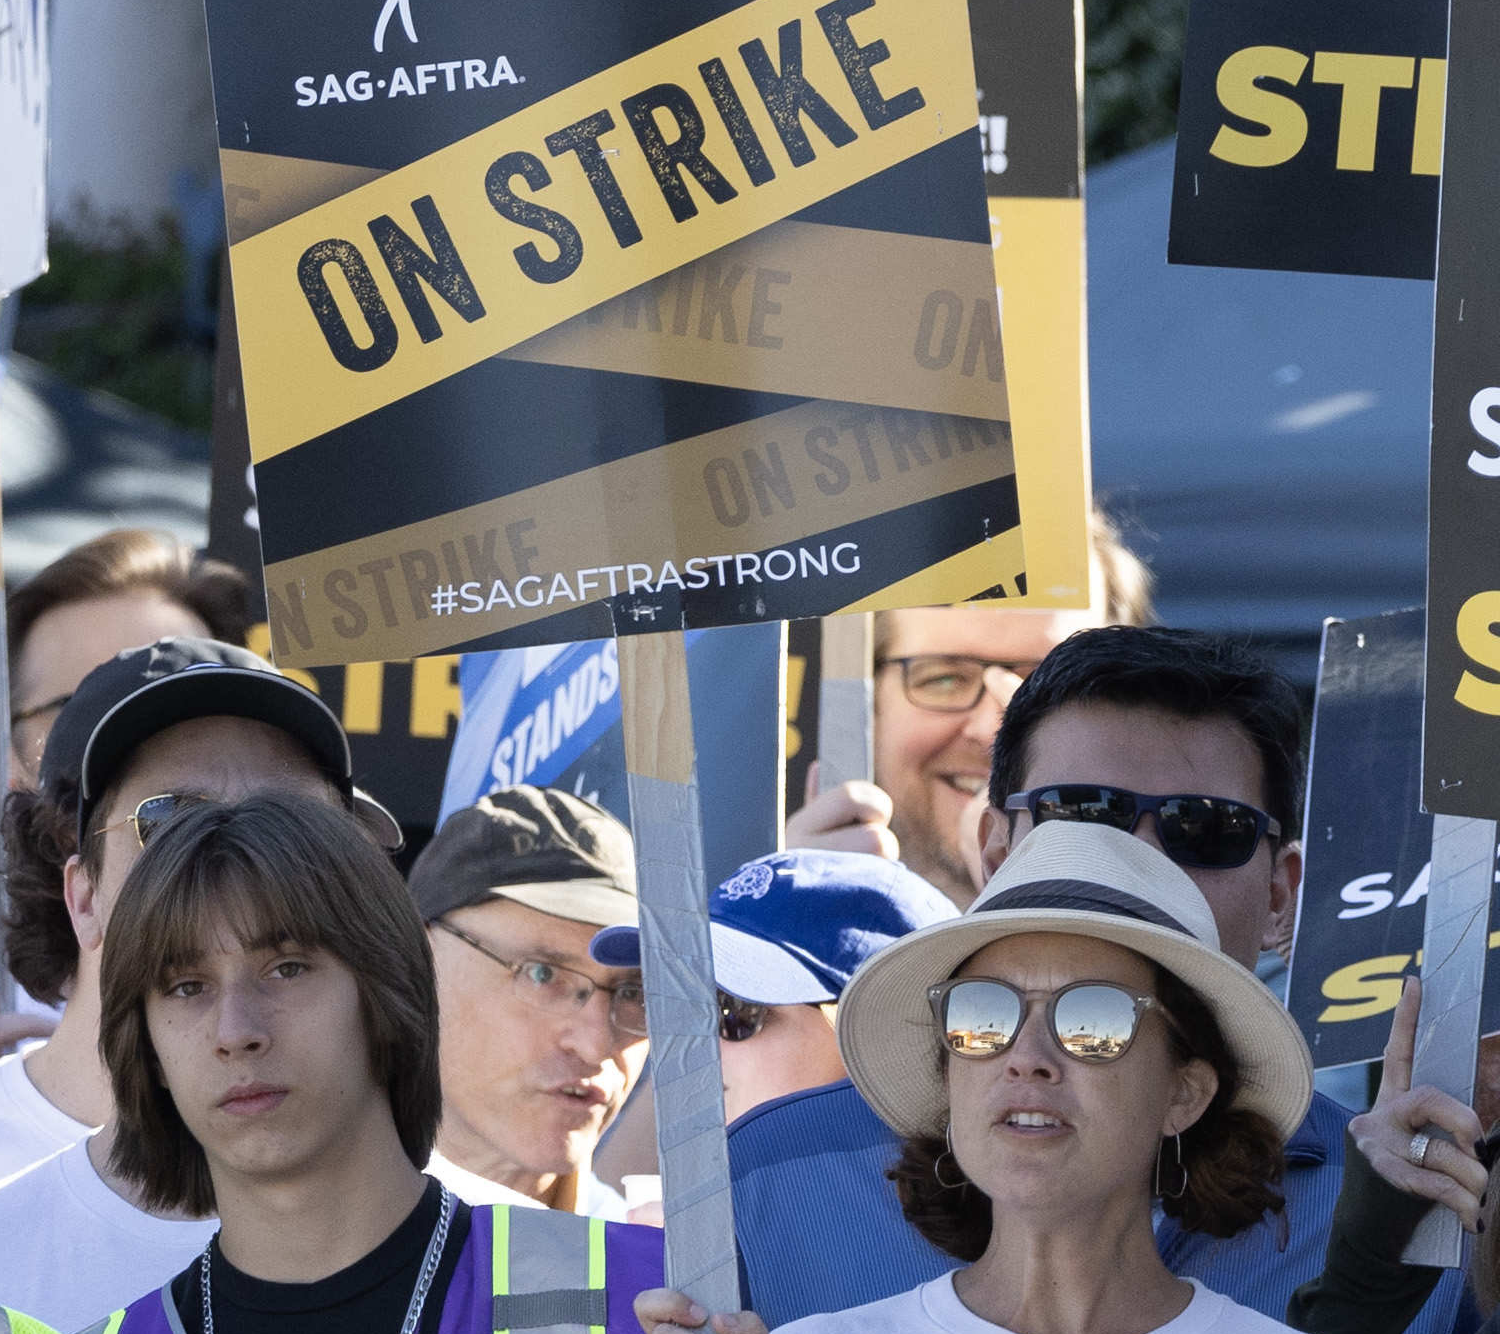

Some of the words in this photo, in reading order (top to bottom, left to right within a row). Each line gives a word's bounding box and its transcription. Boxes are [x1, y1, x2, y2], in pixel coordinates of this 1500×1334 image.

[296, 194, 486, 374] ON
[432, 542, 862, 616] #SAGAFTRASTRONG
[490, 639, 619, 792] STANDS
